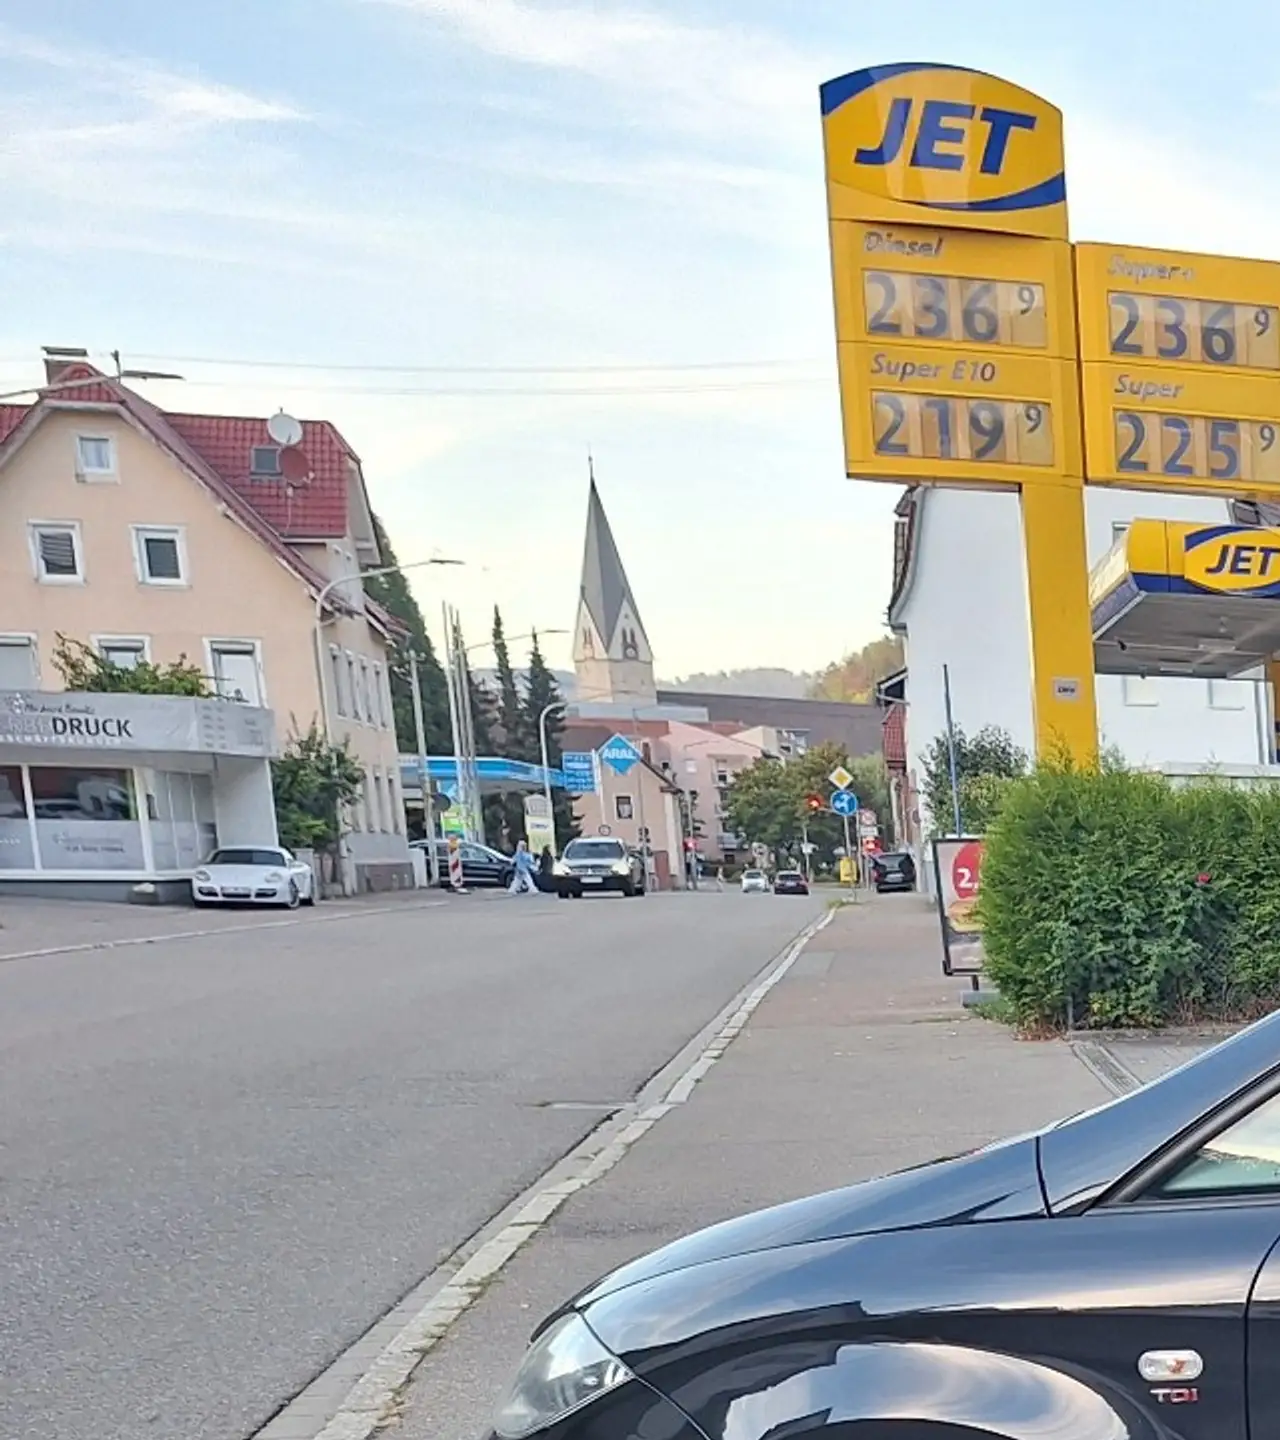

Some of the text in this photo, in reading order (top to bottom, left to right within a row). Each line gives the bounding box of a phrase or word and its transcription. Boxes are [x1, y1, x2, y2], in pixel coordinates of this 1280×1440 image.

[853, 97, 1038, 177] JET
[863, 230, 944, 256] Diesel
[870, 353, 997, 383] Super E10
[1114, 374, 1185, 401] Super
[601, 748, 637, 761] ARAL
[1149, 1387, 1198, 1404] TDI
